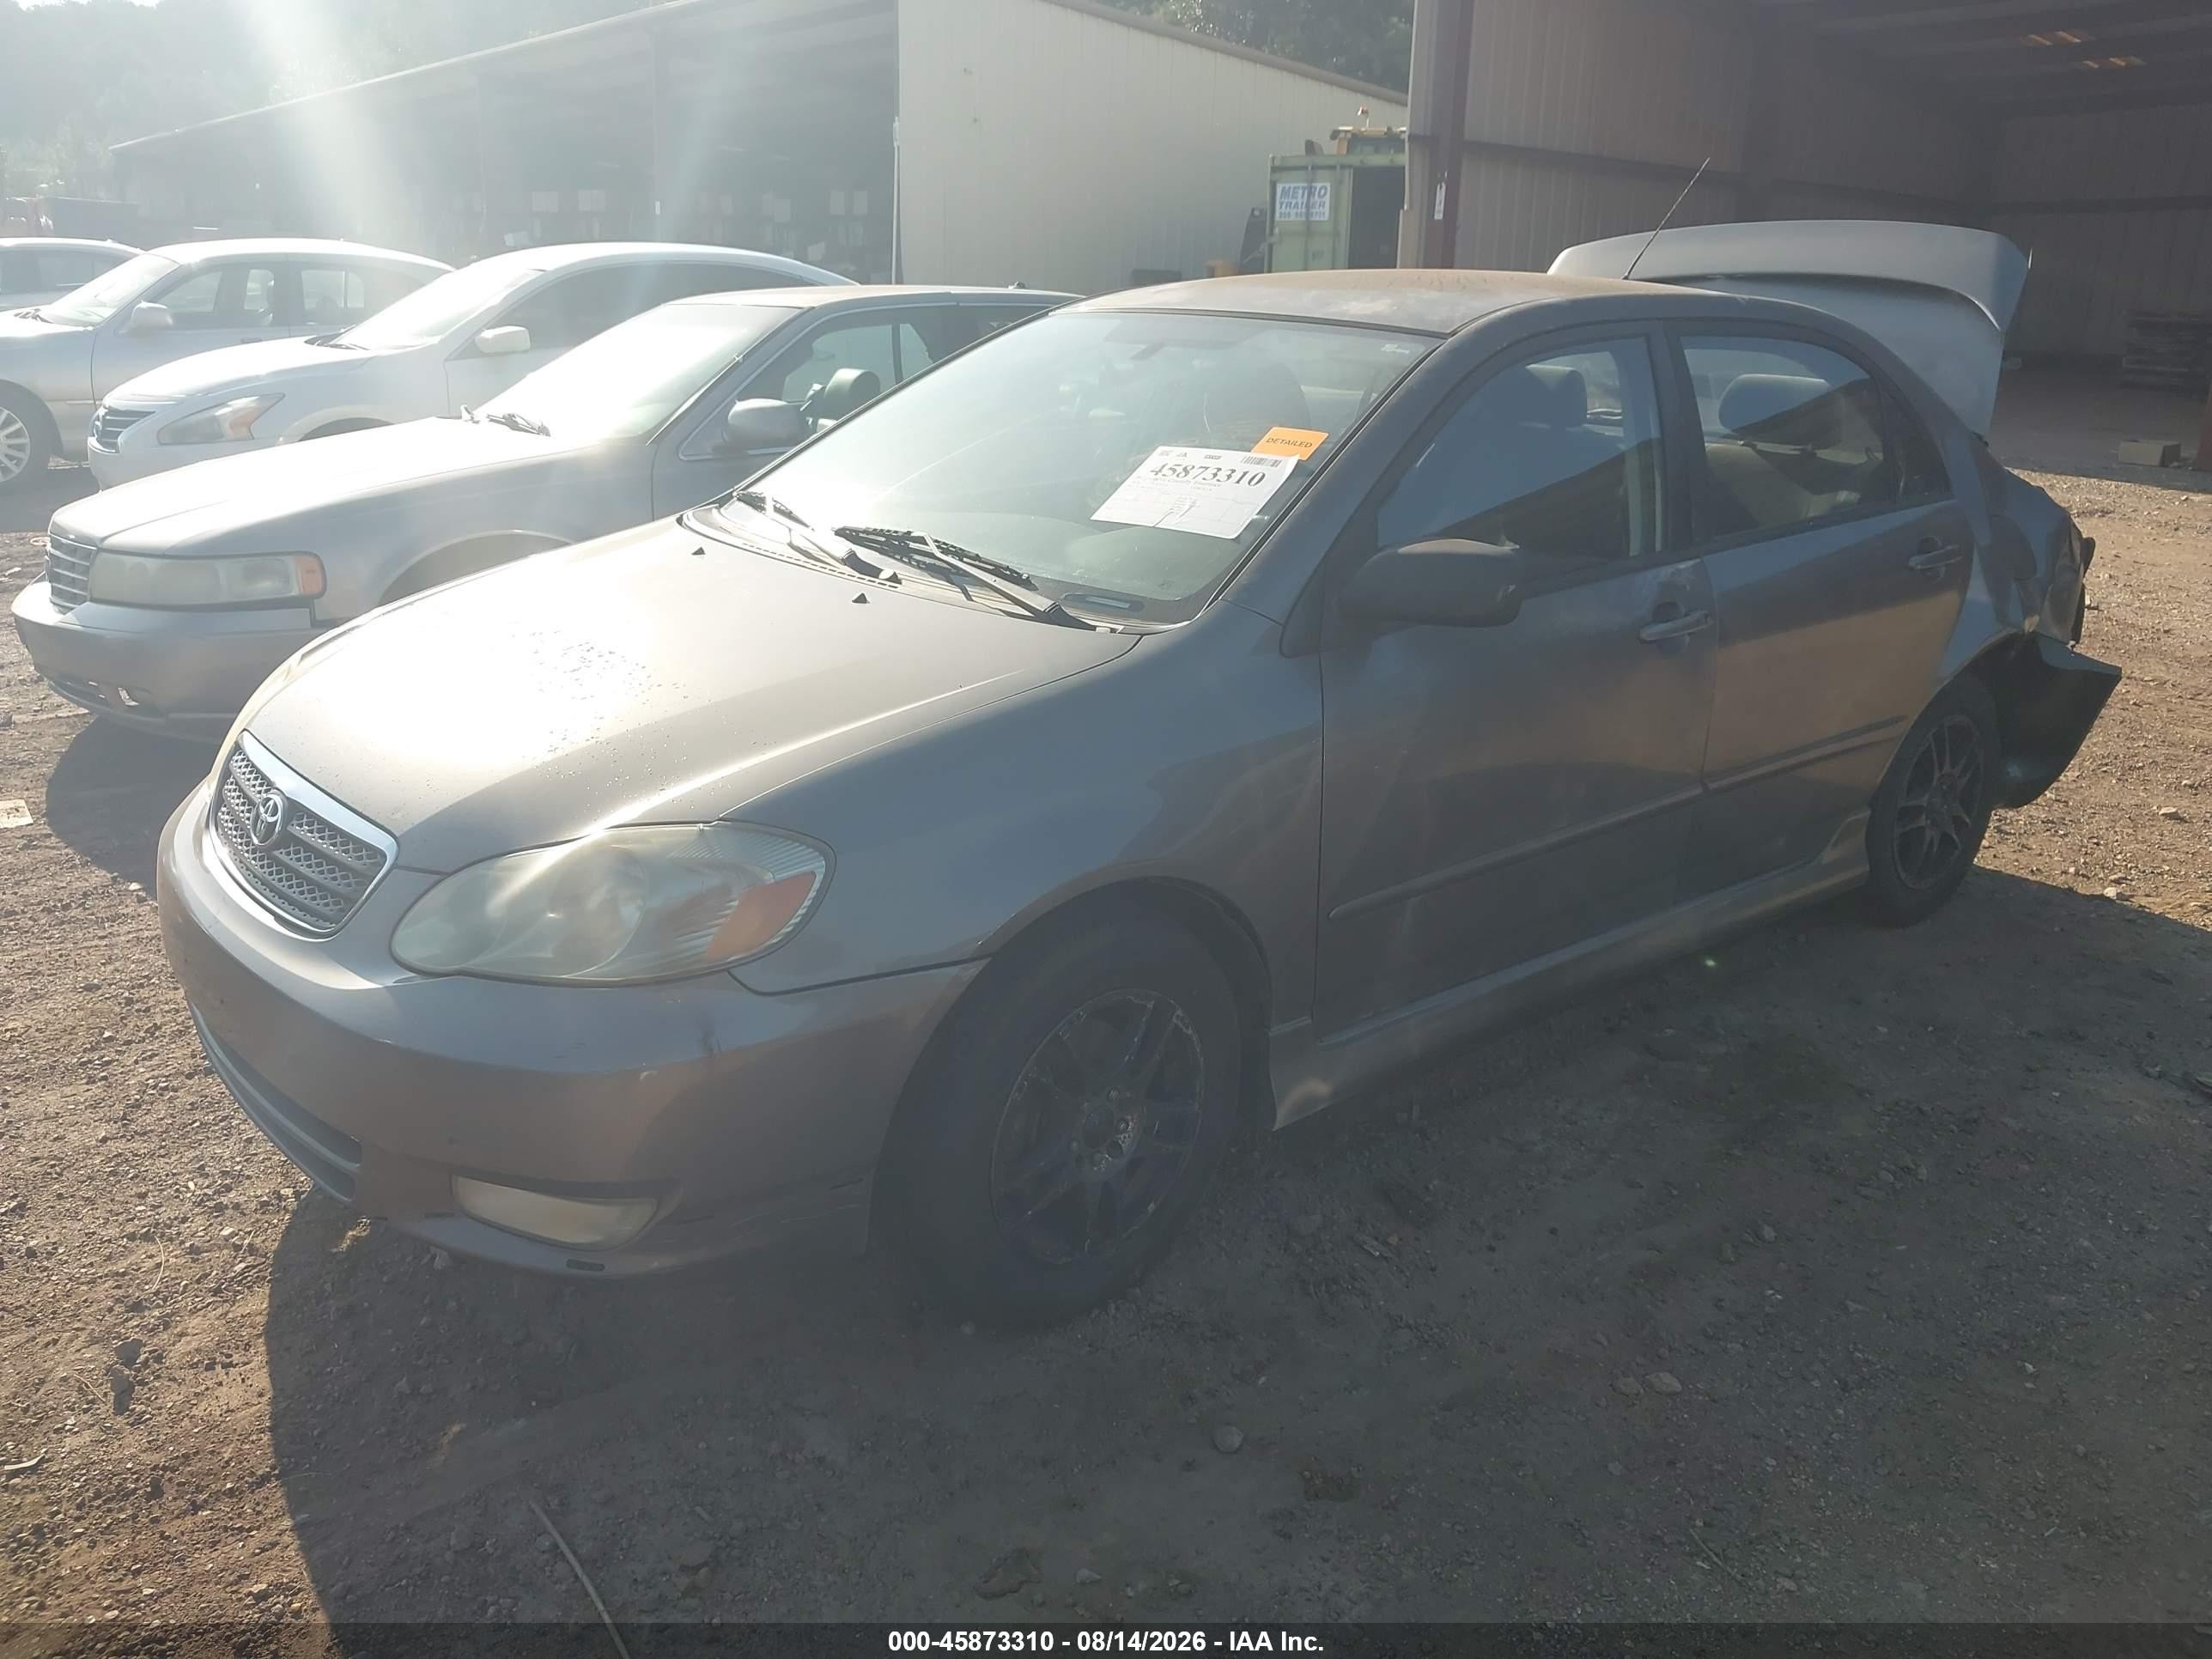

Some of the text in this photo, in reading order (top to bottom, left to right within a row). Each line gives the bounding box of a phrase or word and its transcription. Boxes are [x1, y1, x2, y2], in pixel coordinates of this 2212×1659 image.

[1279, 185, 1328, 199] METRO
[1266, 437, 1313, 447] DETAILED
[1150, 462, 1267, 487] 45873310
